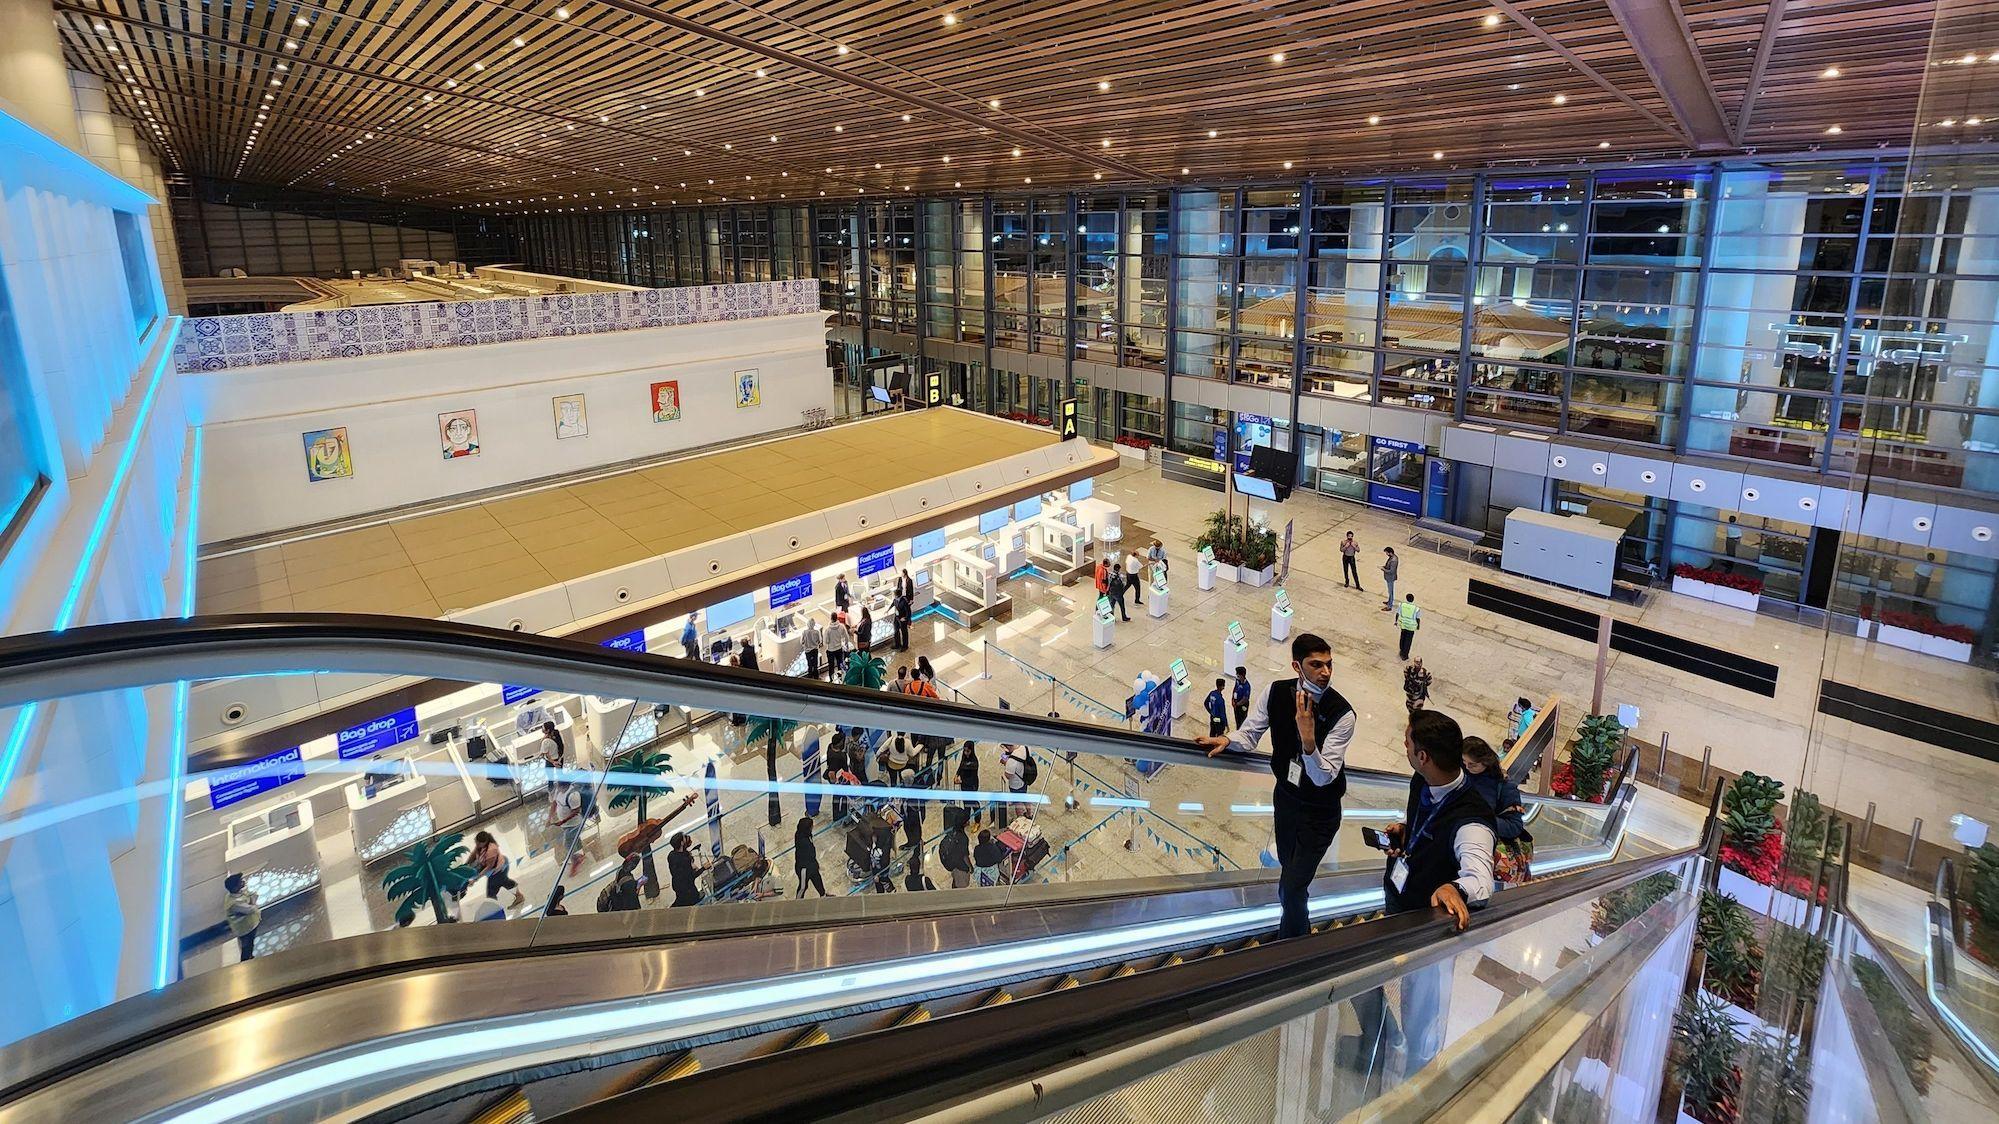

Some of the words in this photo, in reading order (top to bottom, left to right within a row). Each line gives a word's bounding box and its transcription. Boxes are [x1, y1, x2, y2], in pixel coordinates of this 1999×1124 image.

[930, 388, 940, 403] B
[1064, 418, 1075, 435] A
[1388, 439, 1408, 449] FIRST
[771, 584, 786, 594] Bag
[786, 578, 801, 589] drop
[340, 728, 367, 742] Bag
[367, 718, 396, 733] drop
[212, 748, 299, 787] International
